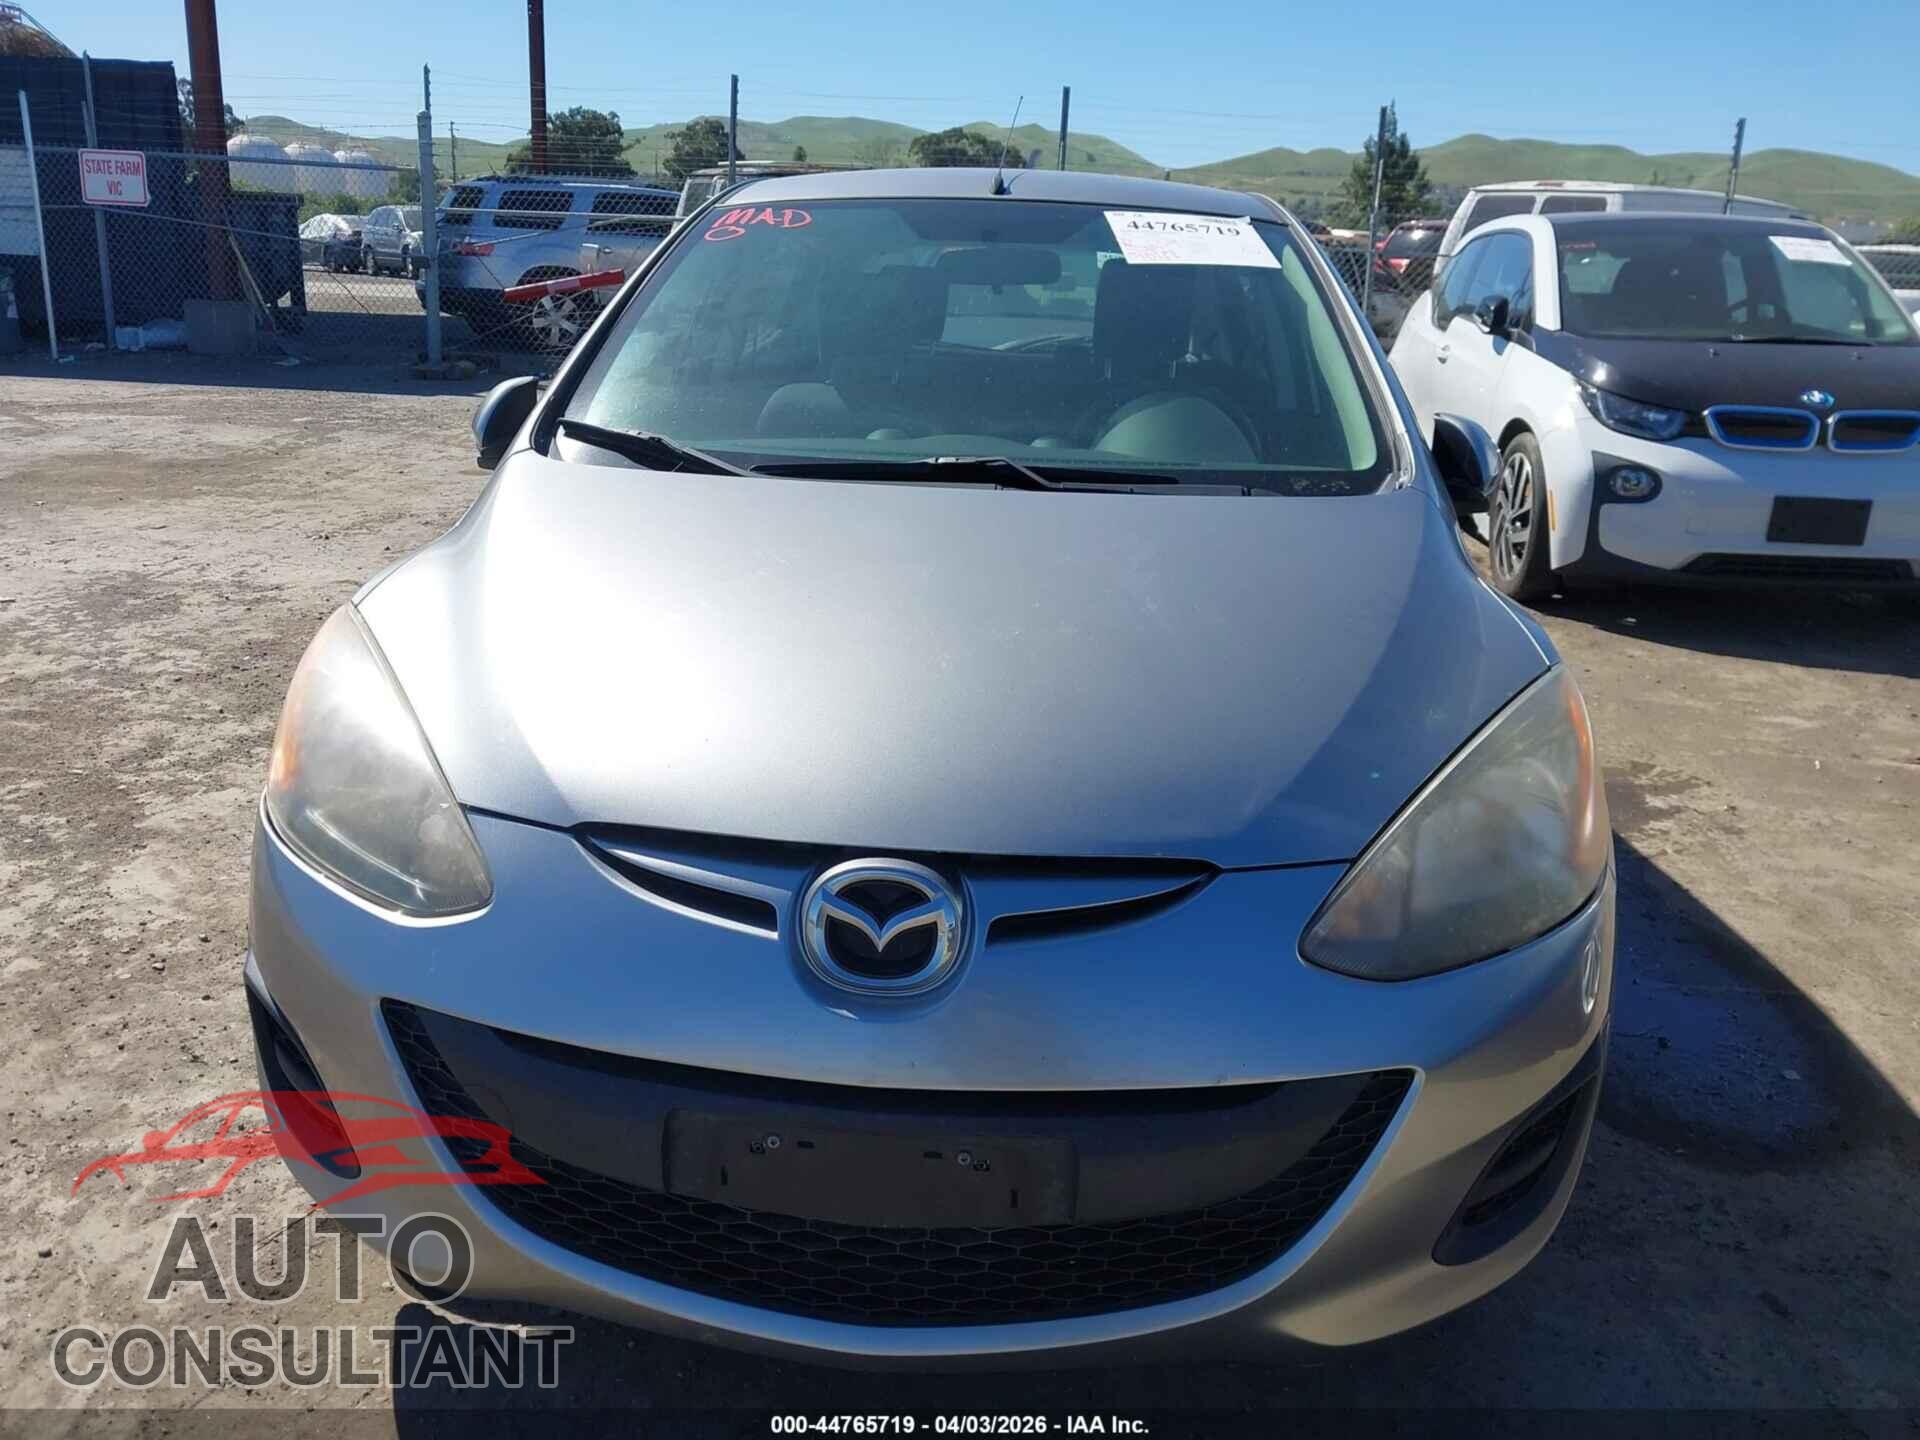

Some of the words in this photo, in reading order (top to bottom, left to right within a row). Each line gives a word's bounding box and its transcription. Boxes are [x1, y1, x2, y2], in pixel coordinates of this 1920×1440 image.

[84, 159, 113, 175] STATE
[115, 161, 141, 176] FARM
[106, 180, 123, 196] VIC
[1126, 219, 1241, 237] 44765719
